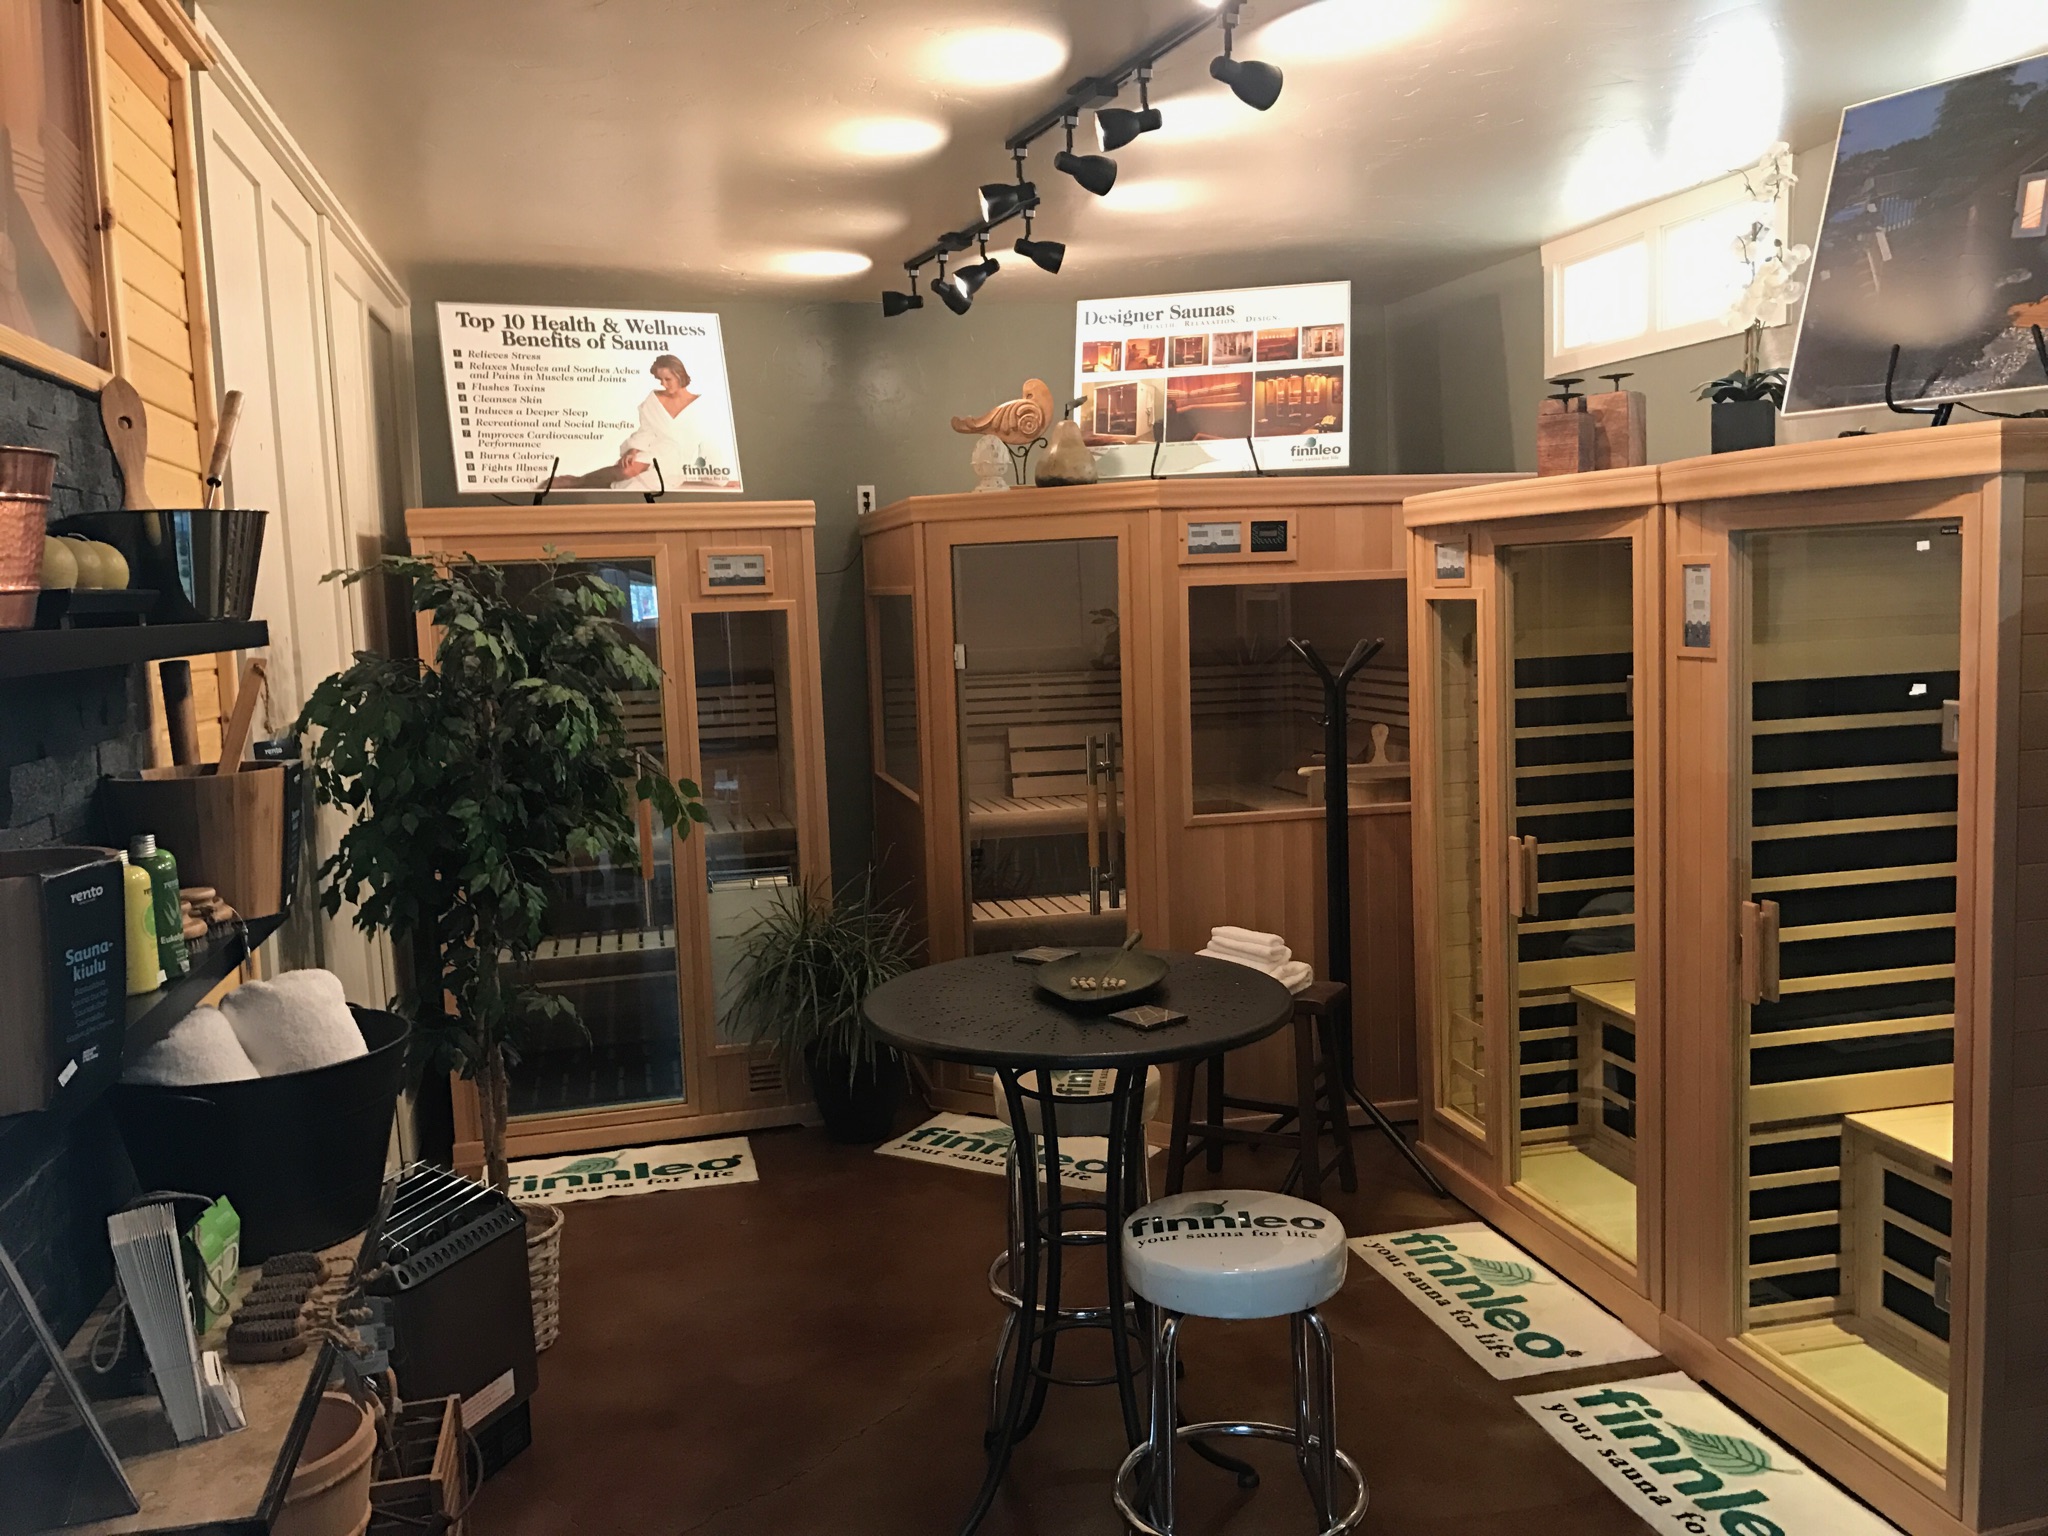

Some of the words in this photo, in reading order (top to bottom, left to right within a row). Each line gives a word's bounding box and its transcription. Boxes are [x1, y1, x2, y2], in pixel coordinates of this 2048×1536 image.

[1085, 308, 1164, 327] Designer
[1169, 304, 1235, 320] Saunas
[455, 311, 495, 332] Top
[502, 313, 525, 330] 10
[531, 314, 596, 333] Health
[603, 317, 620, 334] &
[625, 318, 706, 336] Wellness
[501, 330, 581, 349] Benefits
[587, 333, 606, 350] of
[612, 334, 669, 351] Sauna
[468, 350, 509, 360] Relieves
[511, 351, 541, 360] Stress
[469, 362, 508, 371] Relaxes
[510, 363, 549, 372] Muscles
[551, 365, 571, 373] and
[573, 365, 610, 374] Soothes
[613, 366, 640, 375] Aches
[469, 371, 489, 380] and
[492, 372, 520, 381] Pains
[523, 372, 533, 381] in
[535, 373, 574, 382] Muscles
[577, 374, 596, 383] and
[597, 375, 627, 383] Joints
[471, 382, 510, 392] Flushes
[513, 384, 546, 393] Toxins
[472, 395, 517, 404] Cleanses
[520, 395, 543, 404] Skin
[474, 406, 513, 415] Induces
[525, 407, 560, 417] Deeper
[562, 408, 589, 417] Sleep
[541, 420, 561, 428] and
[563, 420, 594, 429] Social
[597, 420, 635, 431] Benefits
[477, 430, 524, 440] Improves
[527, 431, 604, 440] Cardiovascular
[478, 439, 541, 449] Performance
[1290, 444, 1341, 456] finnleo
[480, 451, 510, 460] Burns
[512, 451, 555, 460] Calories
[481, 463, 513, 473] Fights
[682, 464, 730, 475] finnleo
[483, 475, 508, 484] Feels
[511, 475, 539, 484] Good
[70, 886, 104, 904] rento
[65, 940, 114, 966] Sauna-
[73, 959, 106, 982] kiulu
[894, 1144, 944, 1155] your
[949, 1153, 1005, 1167] sauna
[511, 1191, 553, 1200] our
[565, 1182, 634, 1194] sauna
[647, 1174, 682, 1185] for
[693, 1170, 735, 1181] life
[1128, 1211, 1326, 1238] finnleo
[1137, 1235, 1178, 1248] your
[1186, 1231, 1244, 1239] sauna
[1252, 1229, 1279, 1237] for
[1287, 1229, 1318, 1239] life
[1363, 1240, 1407, 1267] your
[1403, 1271, 1451, 1307] sauna
[1450, 1309, 1480, 1330] for
[1475, 1333, 1514, 1359] life
[1390, 1233, 1565, 1359] finnleo
[1541, 1402, 1602, 1442] your
[1598, 1447, 1672, 1507] sauna
[1671, 1511, 1710, 1536] fo
